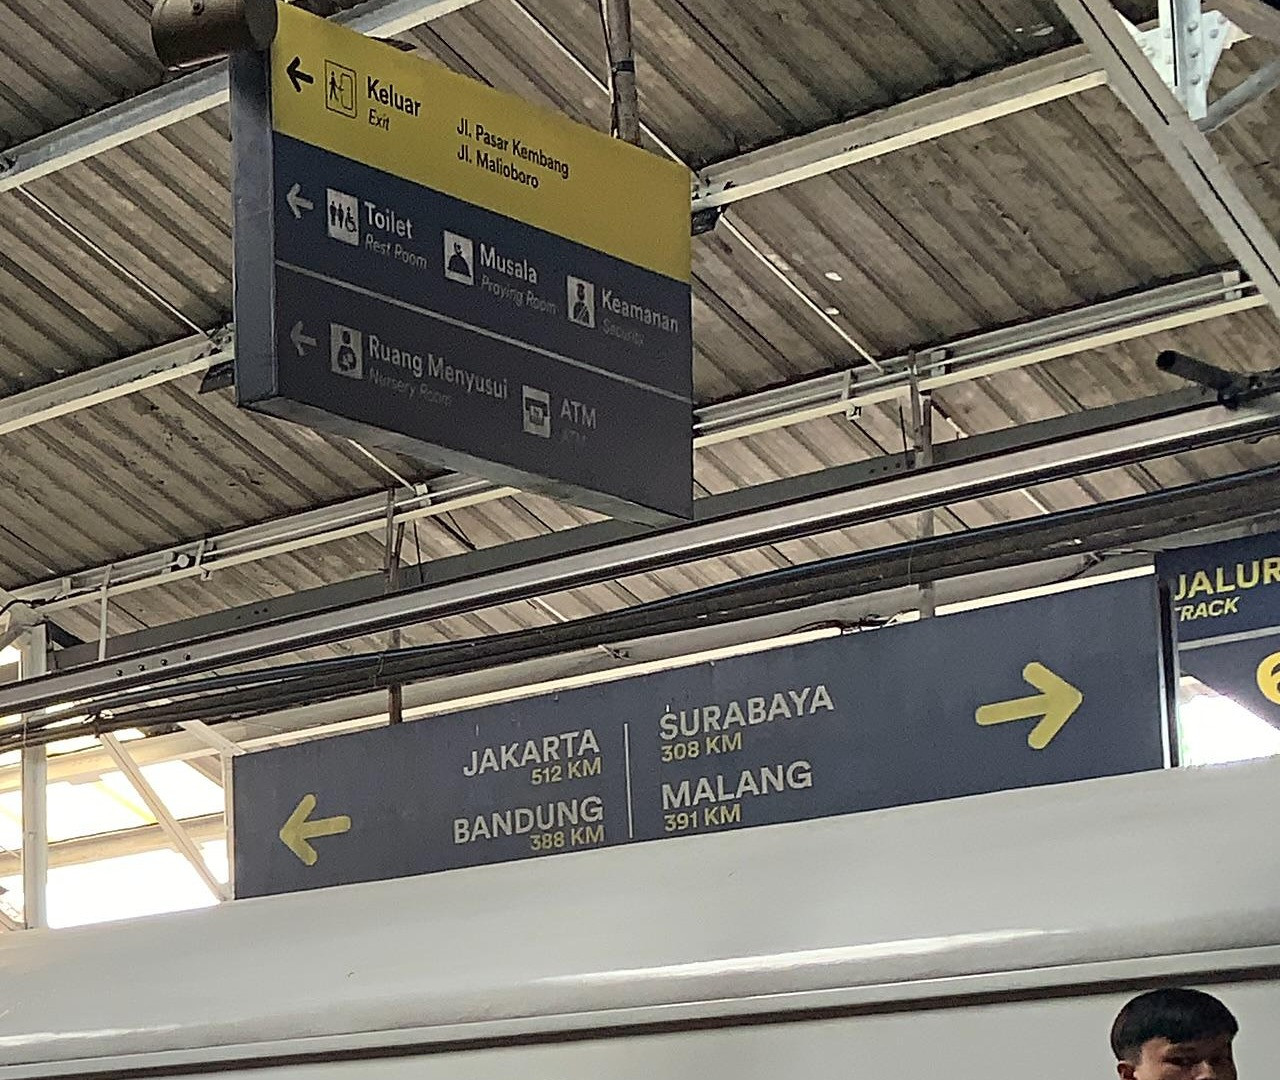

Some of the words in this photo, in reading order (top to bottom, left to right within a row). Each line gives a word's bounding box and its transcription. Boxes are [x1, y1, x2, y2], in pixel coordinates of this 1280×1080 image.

[367, 76, 421, 117] Keluar
[369, 108, 390, 131] Exit
[457, 118, 472, 138] Jl.
[476, 124, 509, 151] Pasar
[512, 138, 569, 179] Kembang
[457, 144, 472, 163] Jl.
[476, 149, 539, 189] Malioboro
[364, 201, 413, 239] Toilet
[365, 233, 390, 255] Rest
[394, 245, 428, 270] Room
[480, 243, 538, 284] Musala
[526, 291, 559, 315] Room
[602, 288, 679, 334] Keamanan
[368, 334, 422, 378] Ruang
[428, 353, 508, 399] Menyusui
[561, 398, 597, 429] ATM
[1174, 556, 1280, 601] JALUR
[659, 685, 834, 741] SURABAYA
[463, 728, 600, 777] JAKARTA
[661, 740, 700, 763] 308
[706, 731, 743, 756] KM
[531, 765, 562, 786] 512
[568, 756, 602, 780] KM
[662, 760, 812, 810] MALANG
[454, 795, 604, 845] BANDUNG
[664, 811, 698, 833] 391
[704, 802, 741, 827] KM
[530, 831, 565, 852] 388
[571, 825, 605, 846] KM
